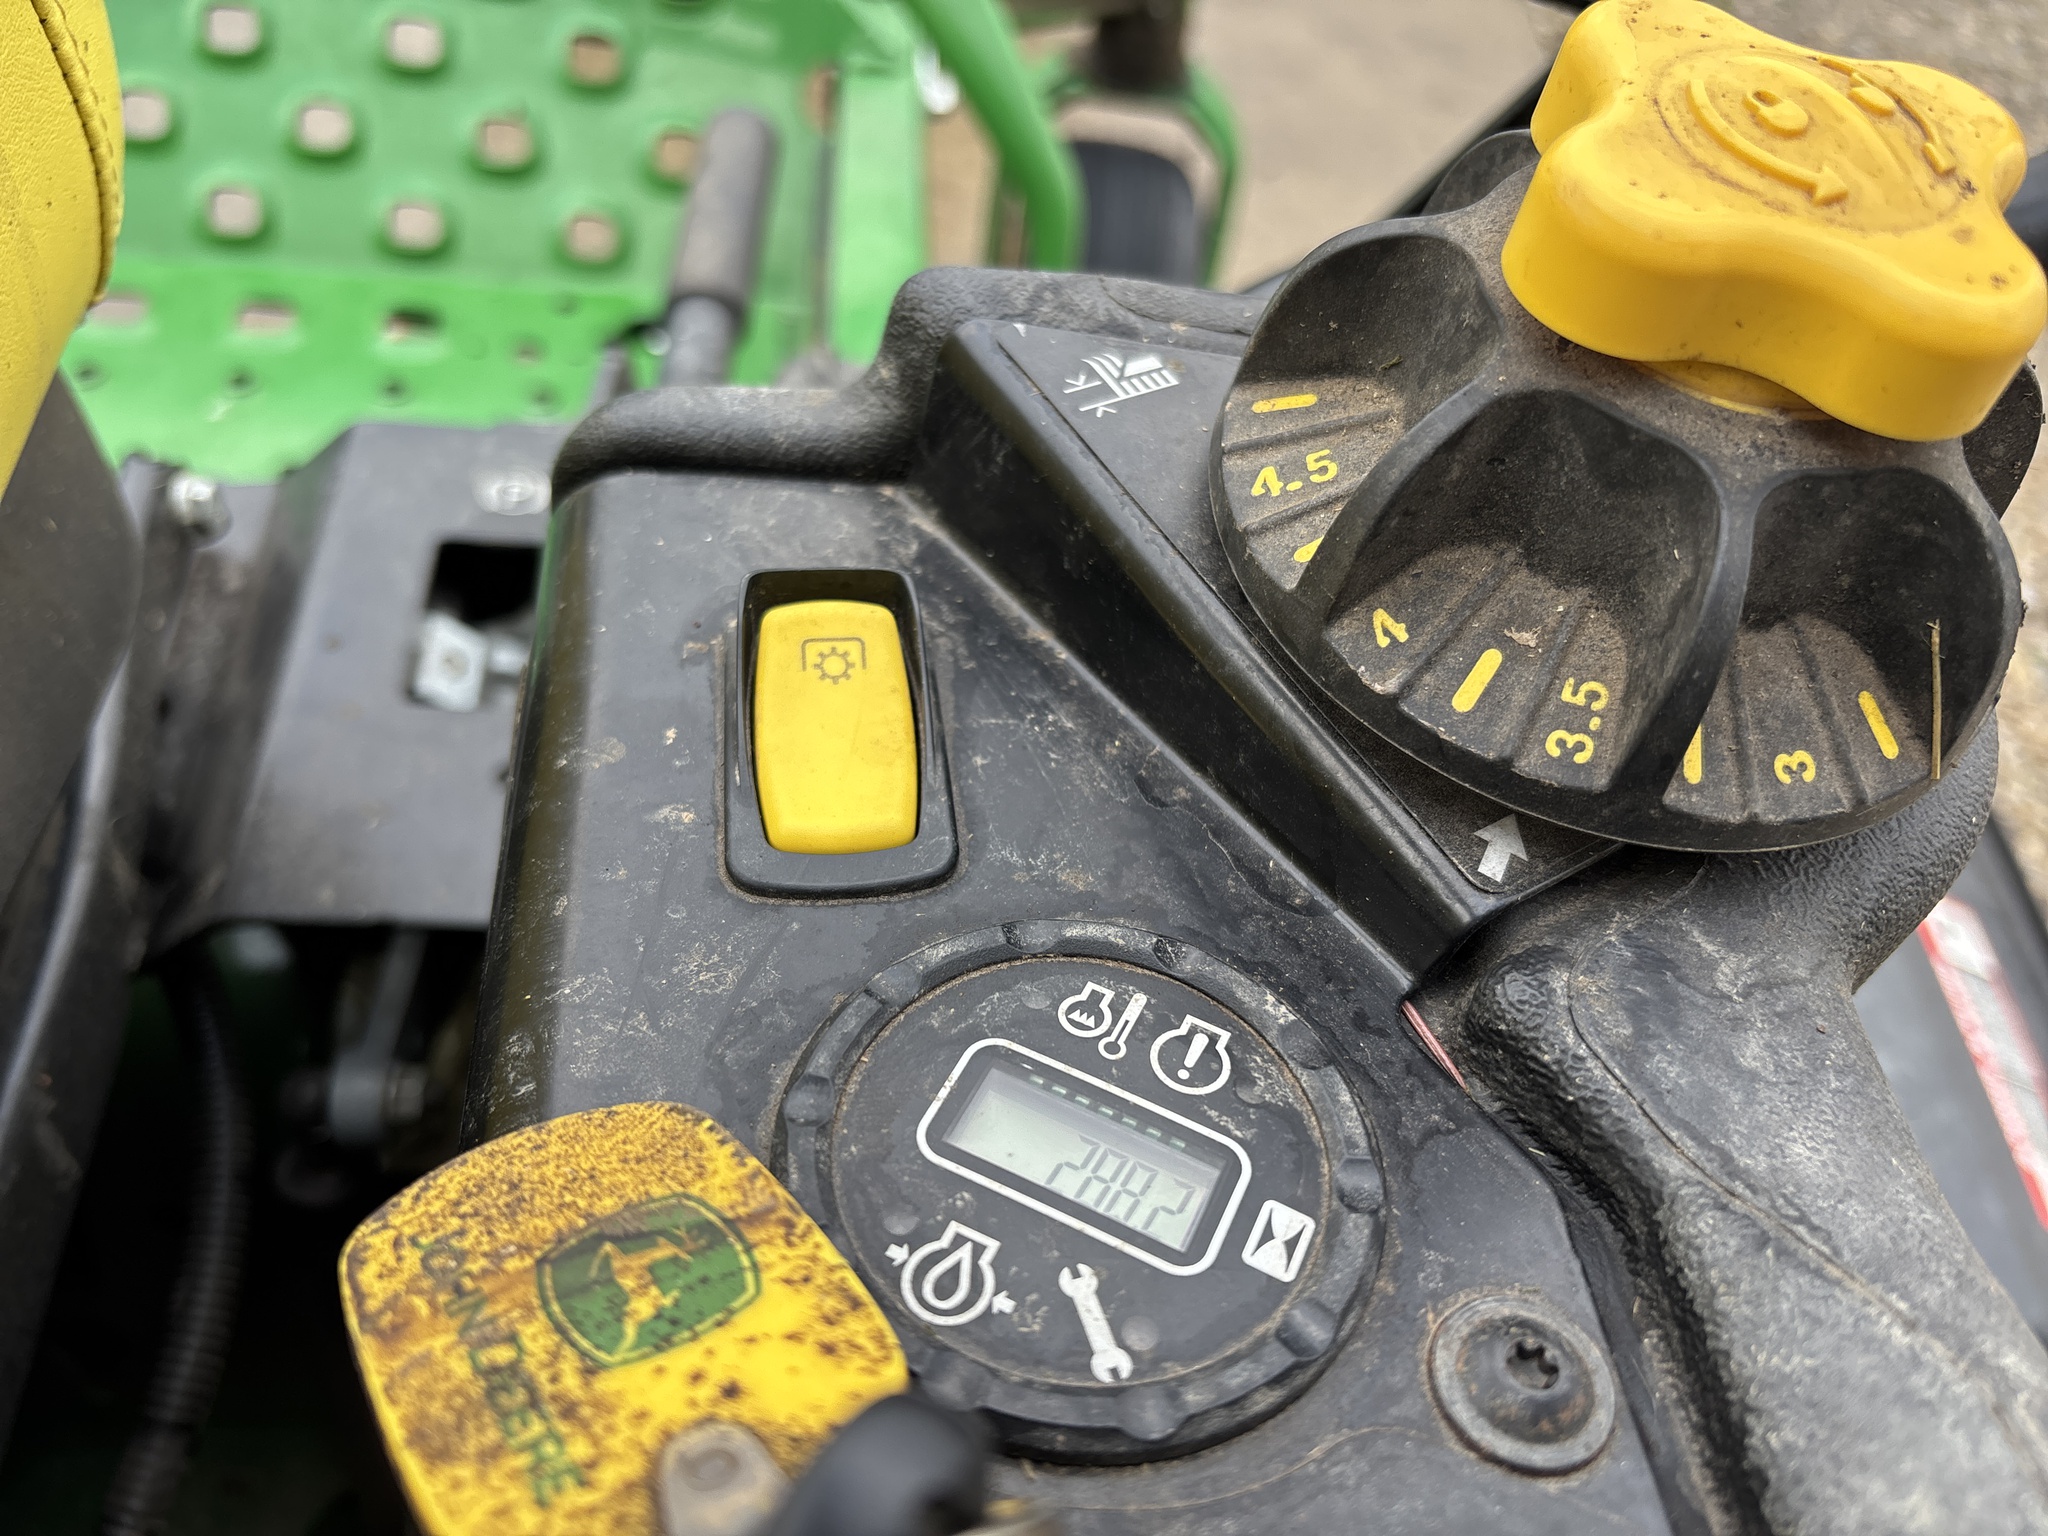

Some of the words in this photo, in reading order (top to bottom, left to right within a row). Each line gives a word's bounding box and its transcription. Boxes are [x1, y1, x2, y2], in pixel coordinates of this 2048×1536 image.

[1251, 449, 1338, 497] 4.5
[1373, 608, 1409, 648] 4
[1545, 677, 1609, 764] 3.5
[1774, 750, 1816, 784] 3
